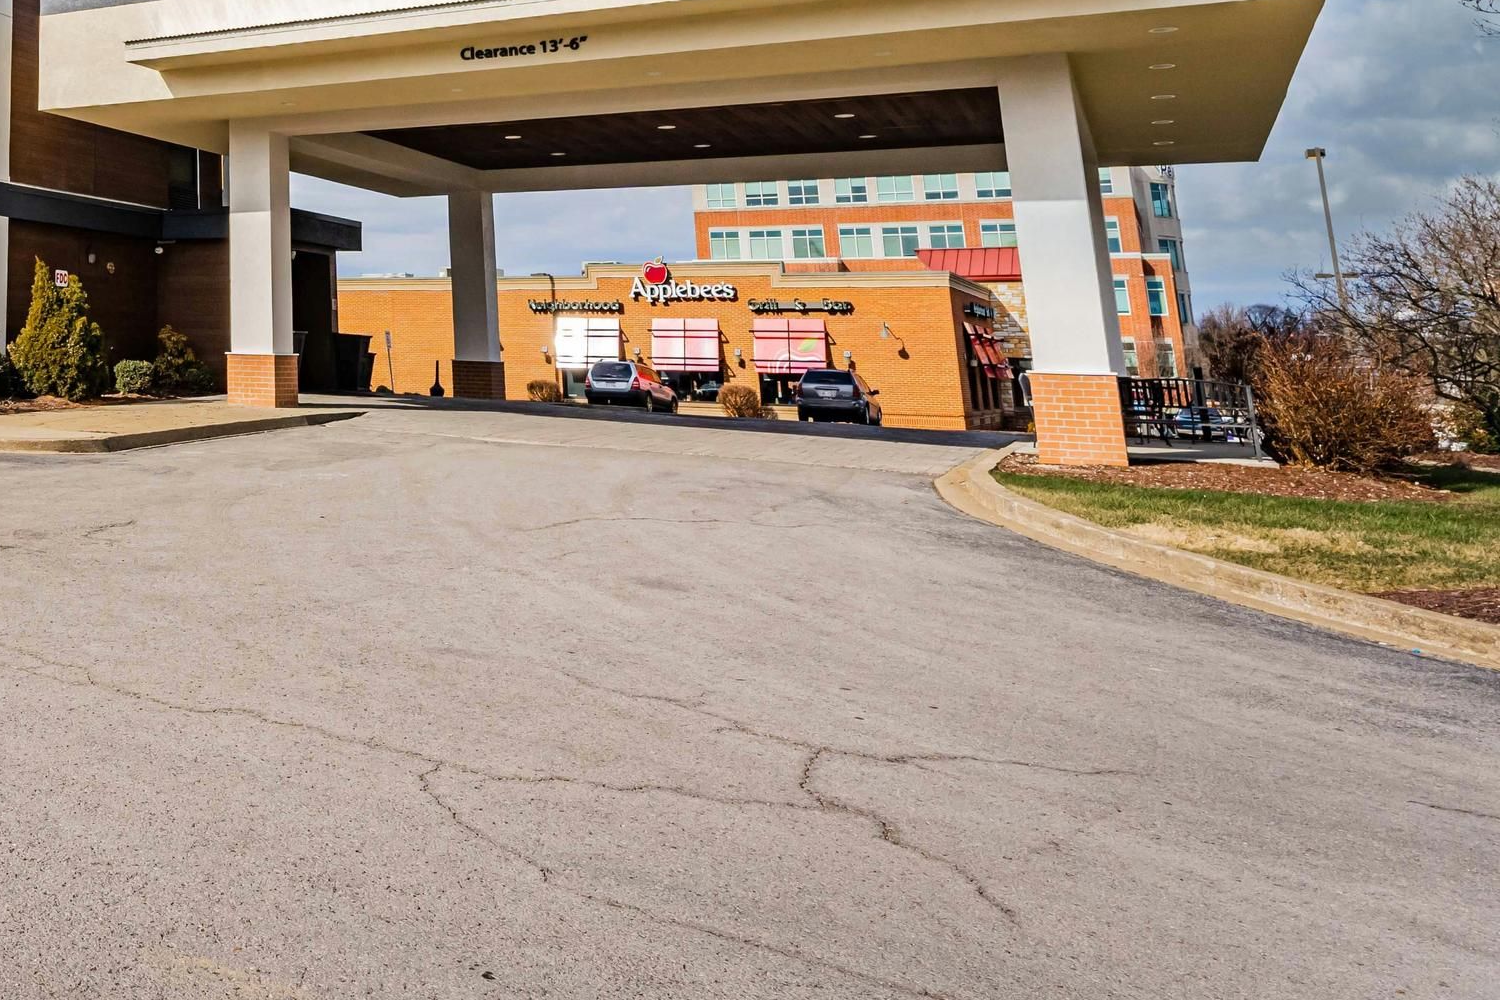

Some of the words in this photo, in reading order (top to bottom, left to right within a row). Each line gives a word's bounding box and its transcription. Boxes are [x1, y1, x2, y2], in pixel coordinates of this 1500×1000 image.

[460, 45, 536, 60] Clearance
[56, 272, 67, 284] FDC
[629, 276, 735, 302] Applebee's
[528, 299, 620, 312] Neighborhood
[748, 299, 779, 311] Grill
